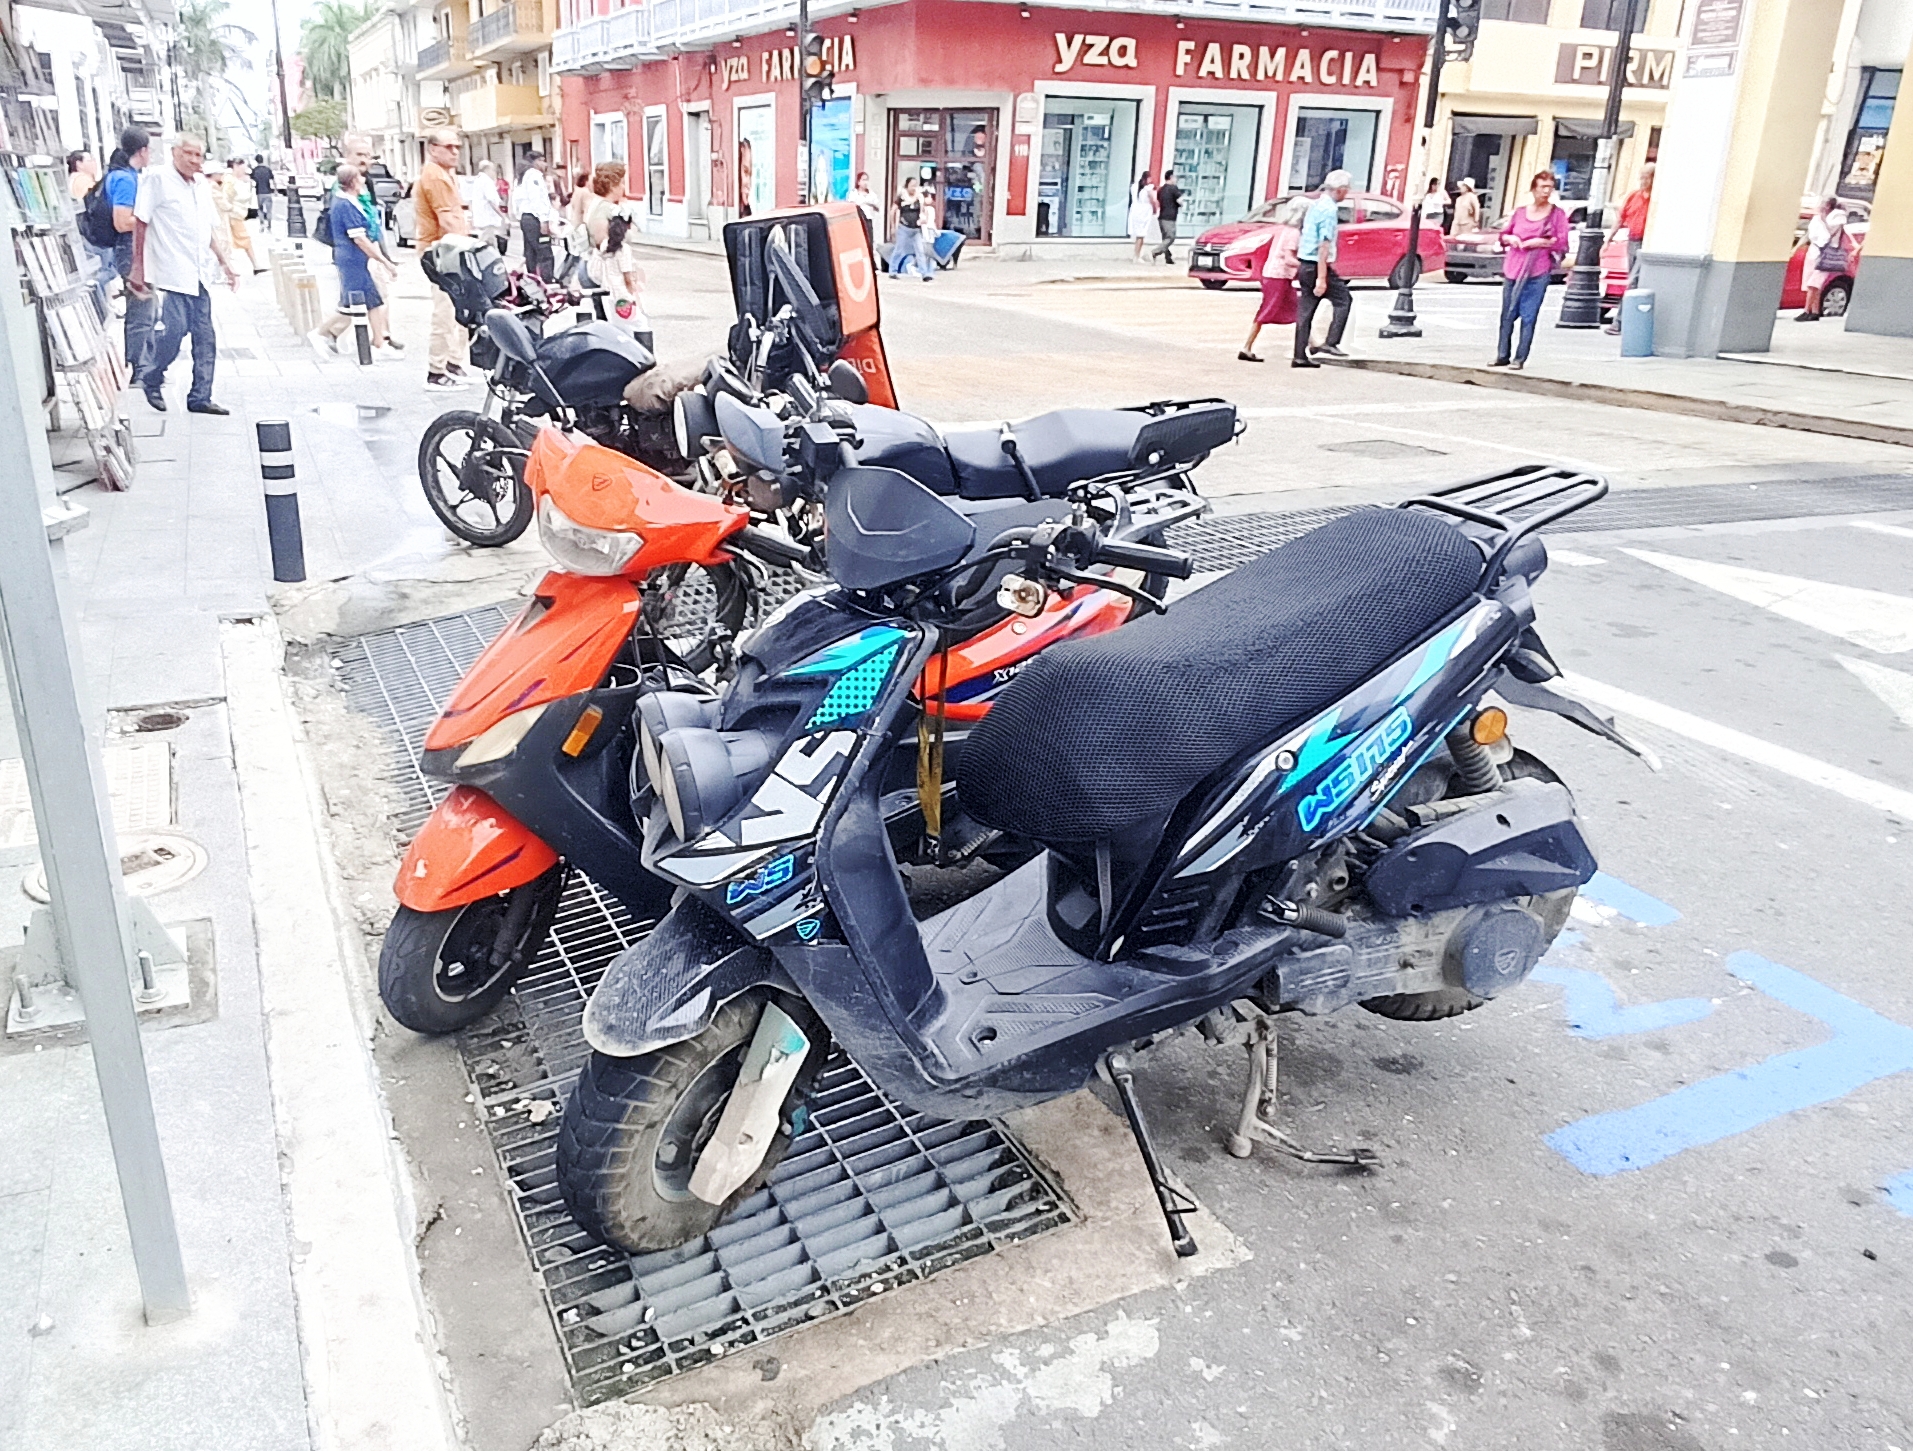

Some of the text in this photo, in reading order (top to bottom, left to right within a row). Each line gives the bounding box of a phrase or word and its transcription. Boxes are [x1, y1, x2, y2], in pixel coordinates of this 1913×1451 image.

[721, 34, 855, 91] yza FARCIA
[1054, 32, 1379, 87] yza FARMACIA
[727, 854, 794, 904] WS
